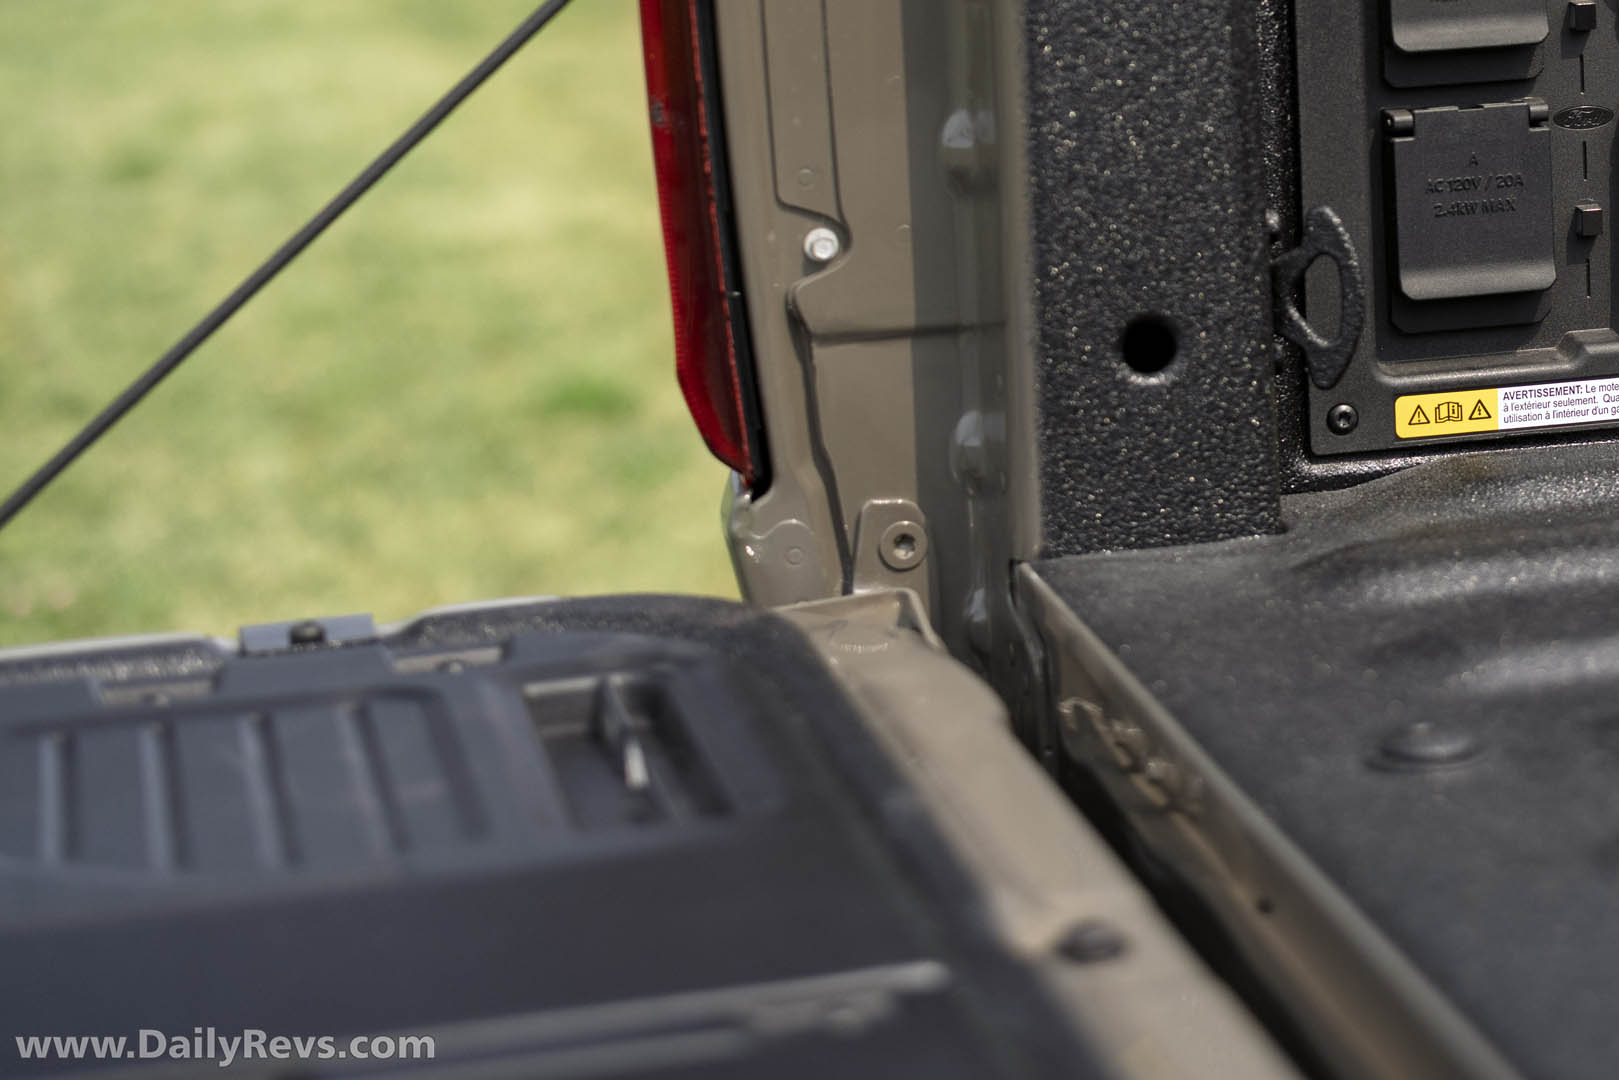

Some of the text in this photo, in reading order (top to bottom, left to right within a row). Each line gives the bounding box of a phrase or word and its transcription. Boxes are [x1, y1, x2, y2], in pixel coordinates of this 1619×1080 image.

[1469, 151, 1479, 166] A
[1425, 178, 1444, 194] AC
[1447, 176, 1482, 192] 120V
[1496, 172, 1524, 189] 20A
[1482, 197, 1516, 215] MAX
[1503, 385, 1583, 401] AVERTISSEMENT:
[1585, 383, 1596, 393] Le
[1503, 403, 1509, 412] à
[1511, 400, 1550, 411] l'extérieur
[1553, 396, 1598, 408] seulement.
[1503, 412, 1542, 424] utilisation
[1545, 411, 1550, 420] à
[1552, 408, 1589, 419] l'intérieur
[1591, 405, 1609, 416] d'un
